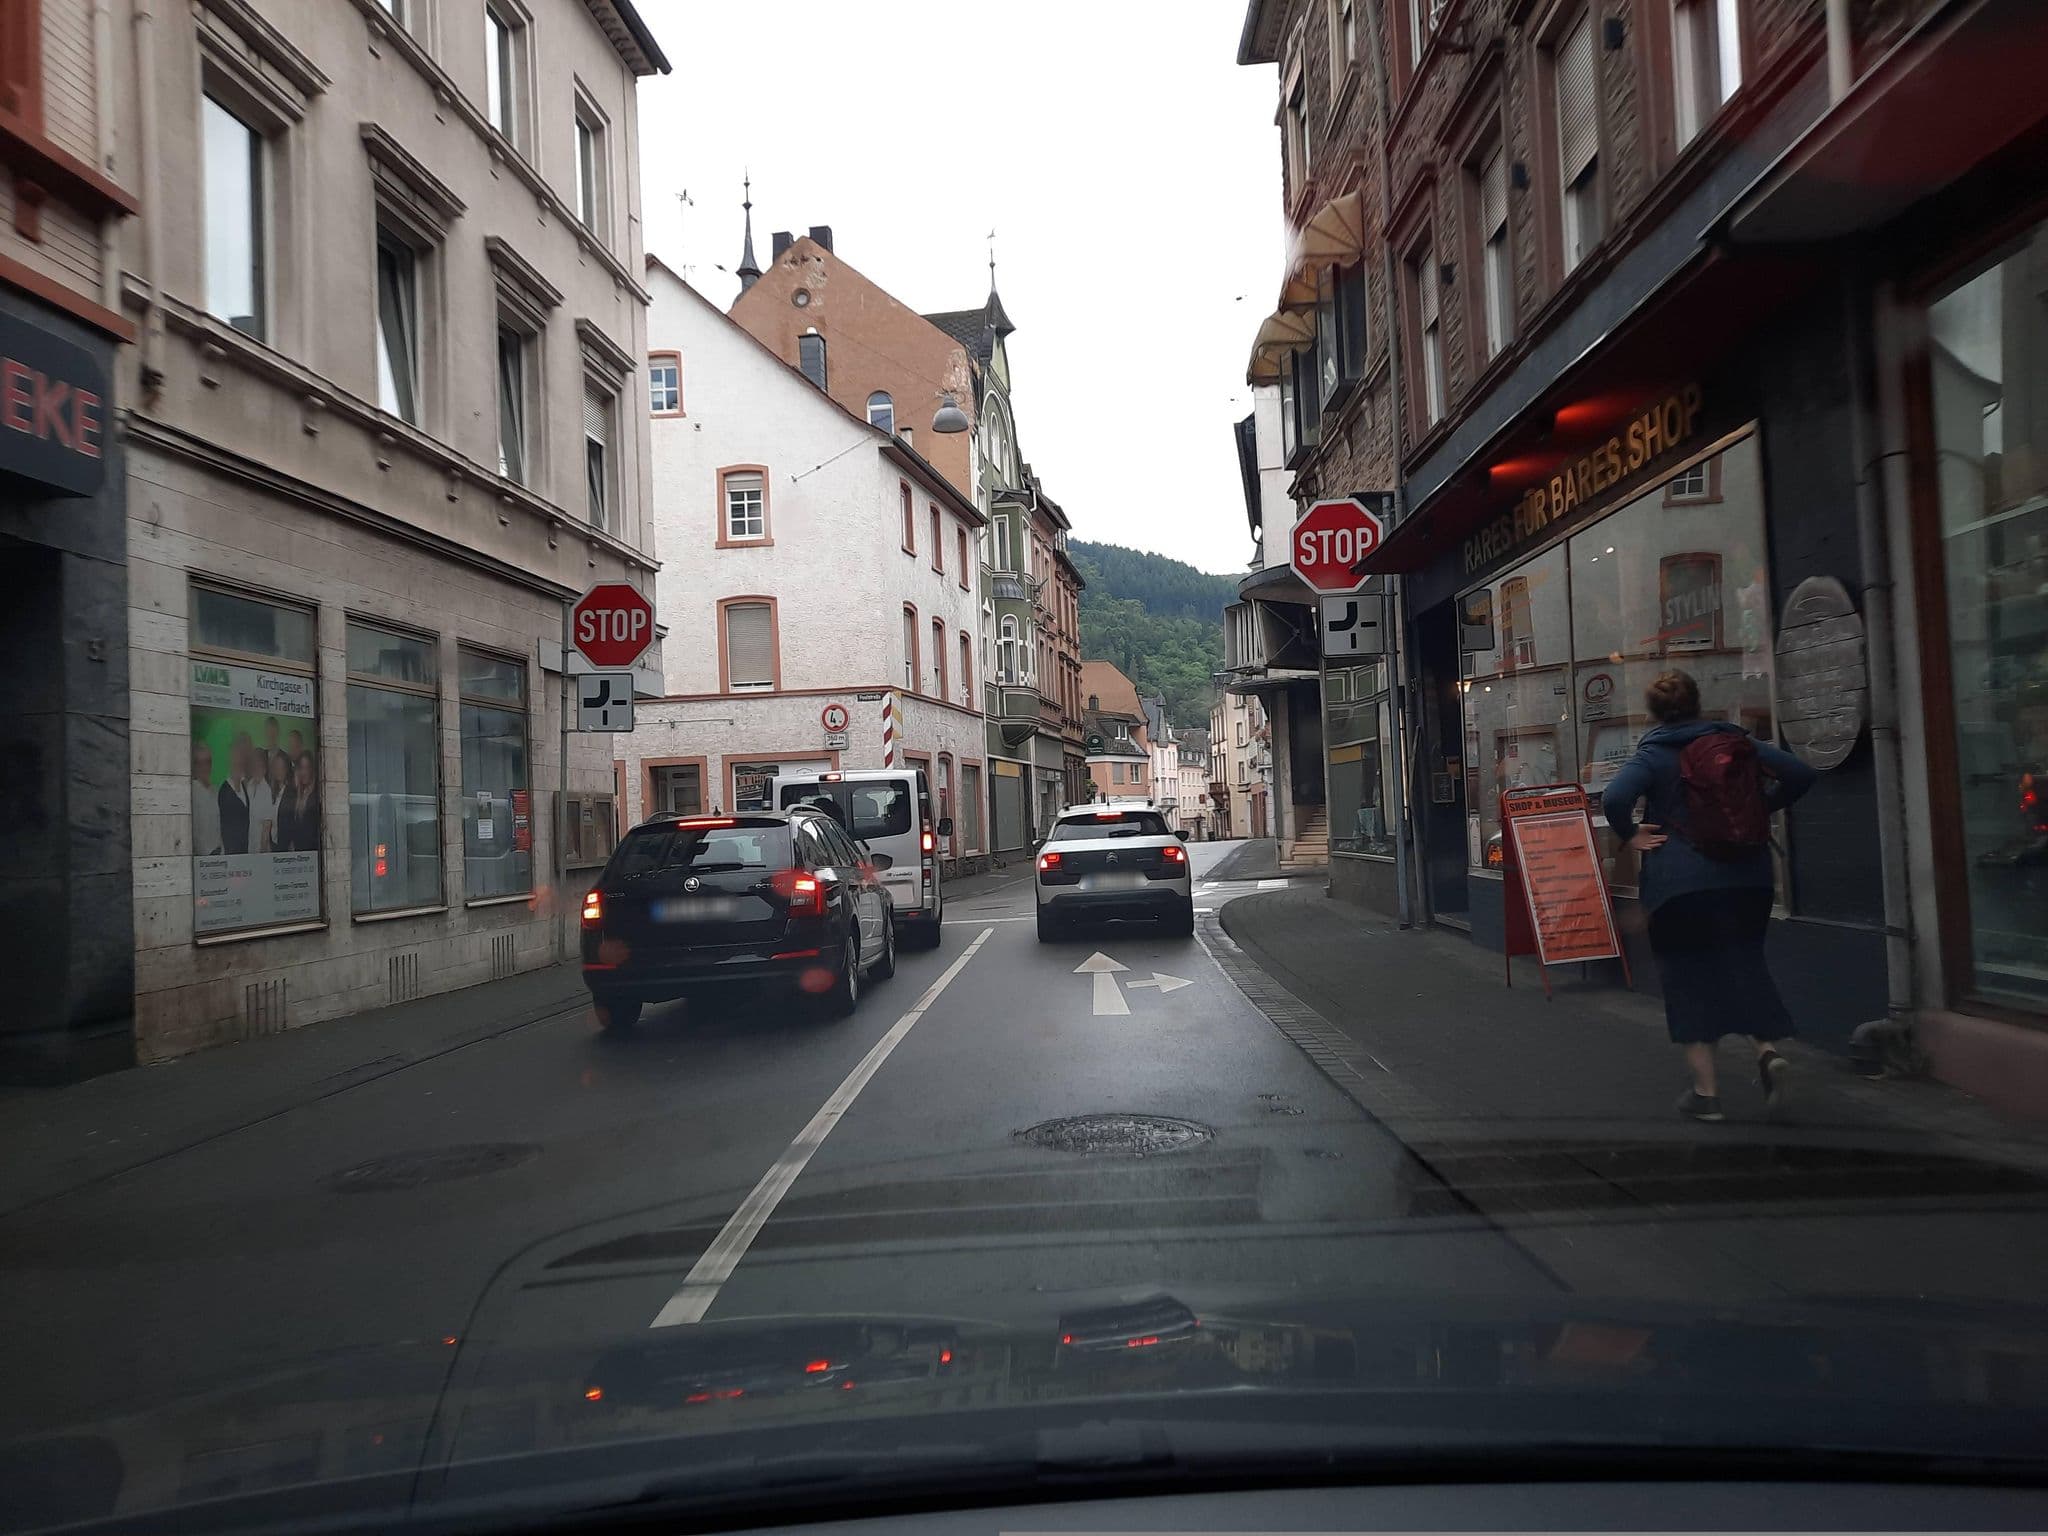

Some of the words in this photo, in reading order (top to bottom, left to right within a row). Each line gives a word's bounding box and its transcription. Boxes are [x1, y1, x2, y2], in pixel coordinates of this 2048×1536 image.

[1, 356, 104, 459] EKE
[1300, 527, 1374, 566] STOP
[1464, 514, 1513, 575] RARES
[1514, 486, 1548, 541] FÜR
[579, 608, 647, 643] STOP
[256, 674, 303, 696] Kirchgasse
[304, 682, 309, 694] 1
[238, 691, 311, 715] Traben-Trarbach
[1509, 801, 1533, 812] SHOP
[1543, 795, 1583, 809] MUSEUM
